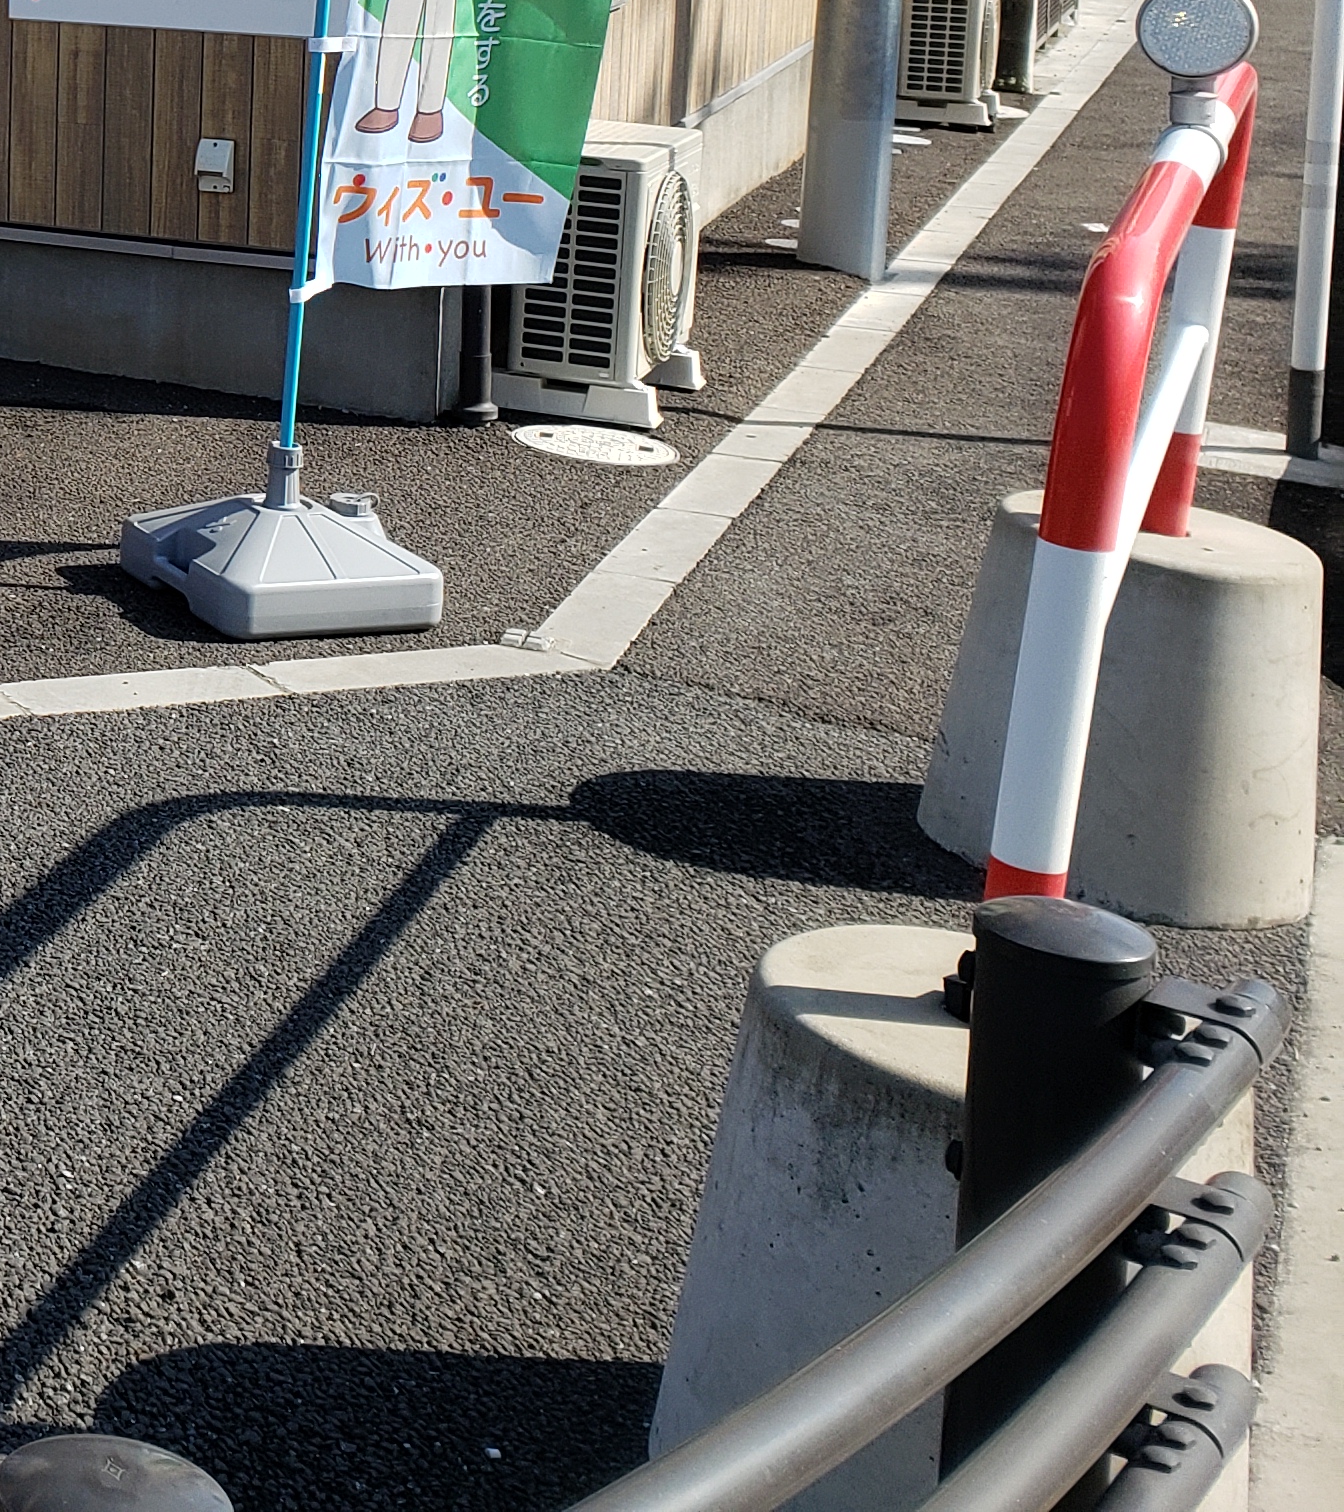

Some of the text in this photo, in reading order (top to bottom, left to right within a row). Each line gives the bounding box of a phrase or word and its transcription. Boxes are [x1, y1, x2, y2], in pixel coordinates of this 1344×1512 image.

[333, 173, 544, 225] ウィズ・ユー
